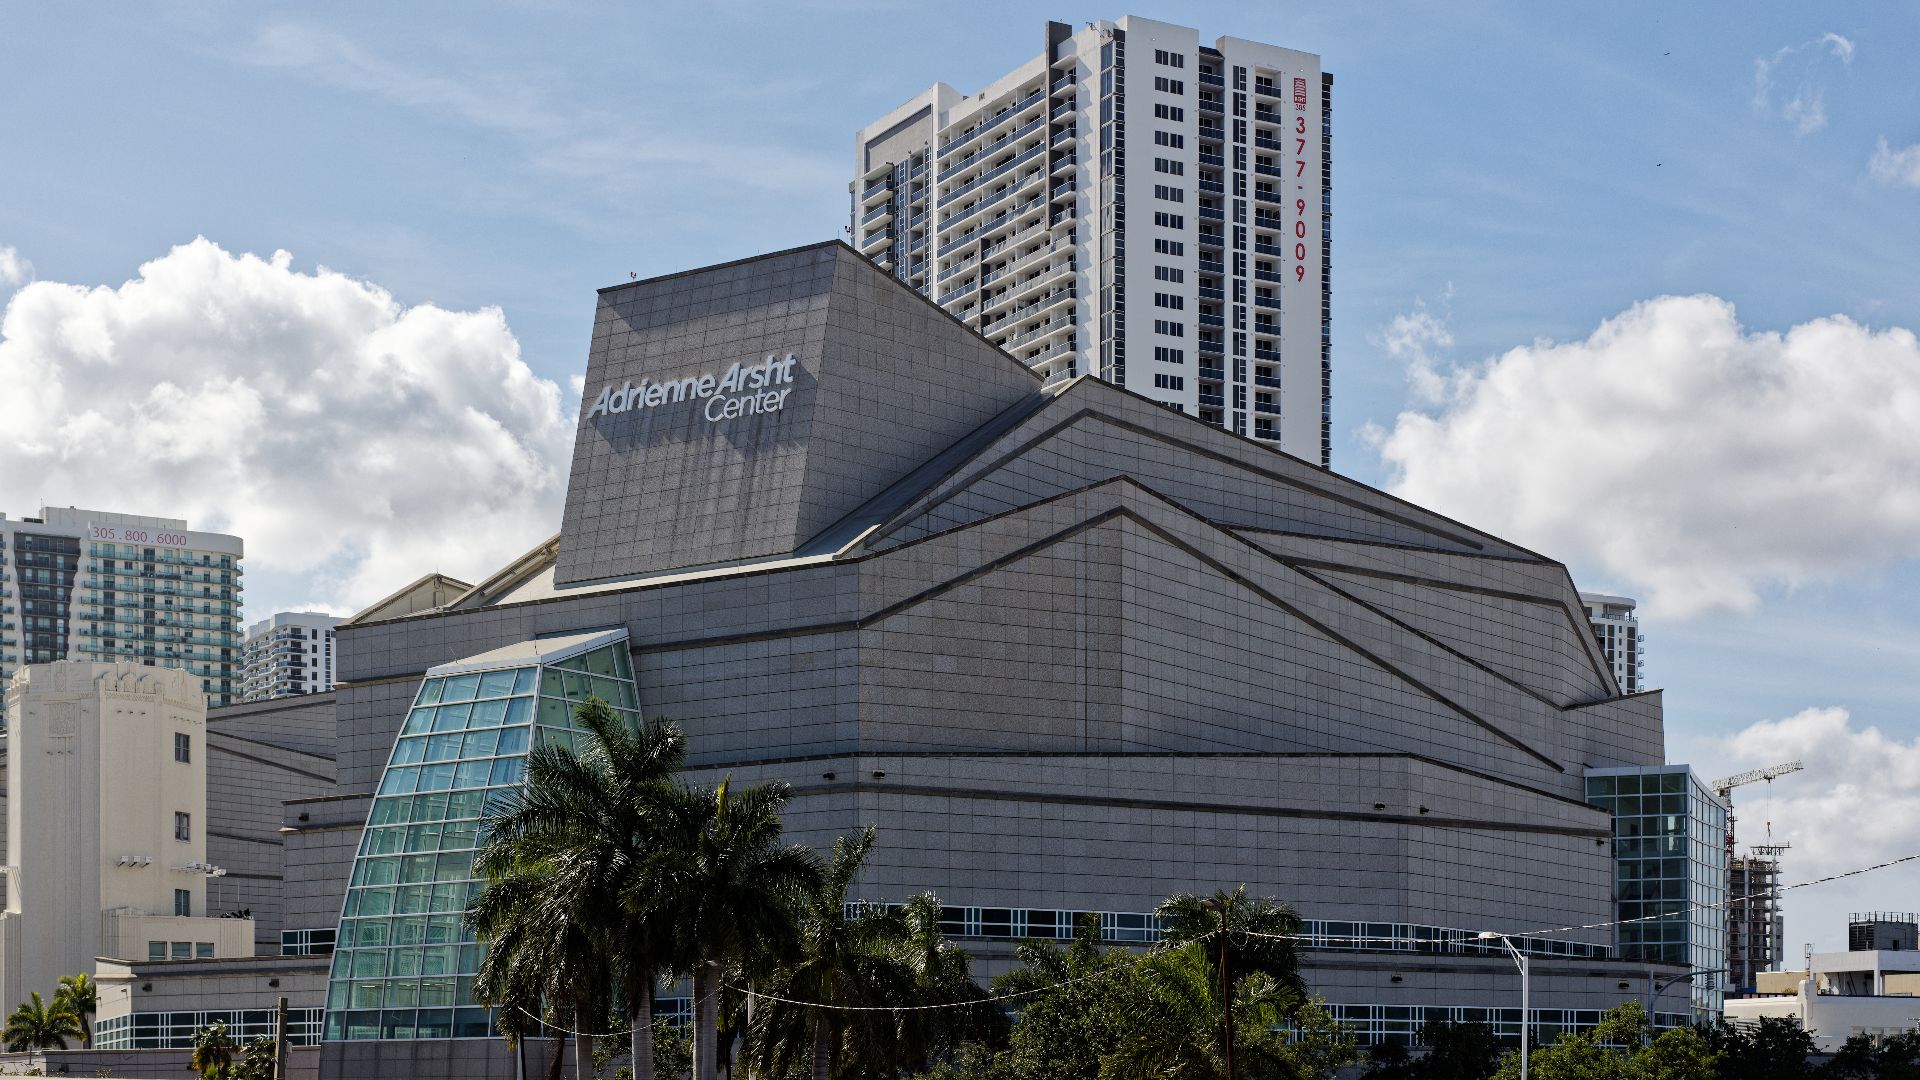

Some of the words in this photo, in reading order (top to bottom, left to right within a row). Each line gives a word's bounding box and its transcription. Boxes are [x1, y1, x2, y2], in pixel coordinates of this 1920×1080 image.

[587, 374, 716, 419] Adrienne
[714, 353, 796, 395] Arsht
[704, 387, 792, 422] Center
